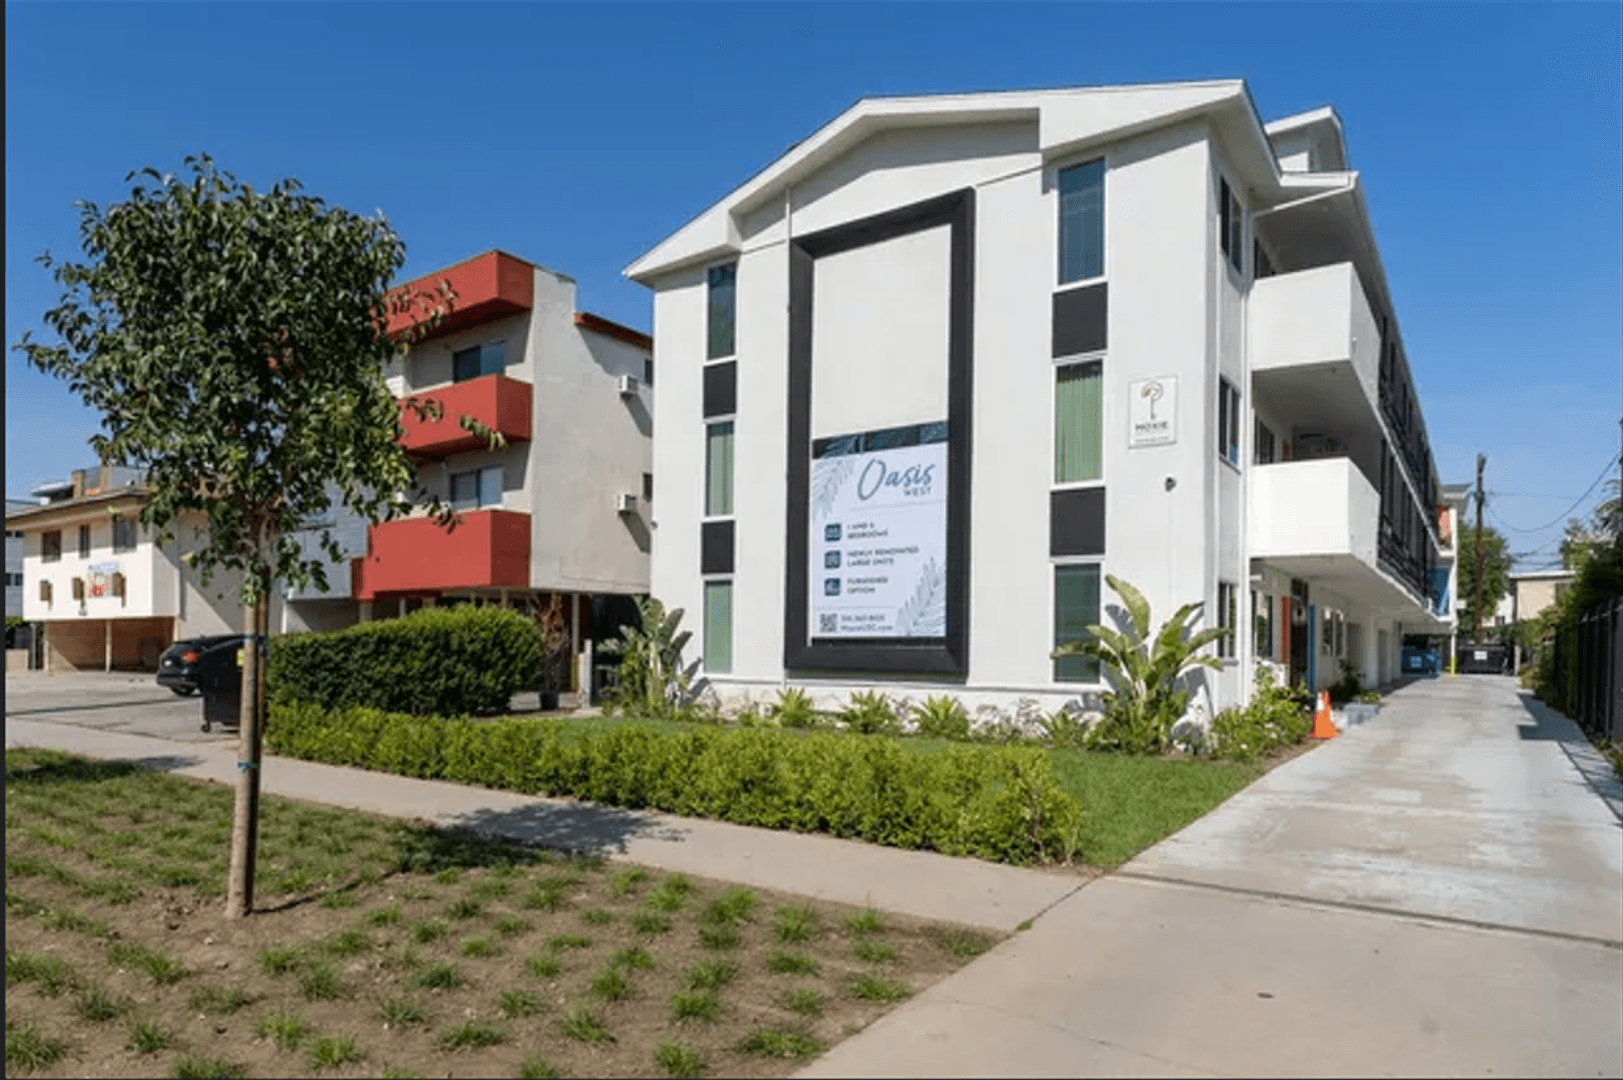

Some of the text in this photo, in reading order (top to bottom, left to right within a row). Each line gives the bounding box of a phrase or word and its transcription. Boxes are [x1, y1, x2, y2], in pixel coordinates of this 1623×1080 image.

[857, 458, 936, 501] Oasis
[903, 486, 932, 498] WEST
[847, 529, 888, 539] BEDROOMS
[847, 546, 919, 557] NEWLY RENOVATED
[847, 558, 870, 567] LARGE
